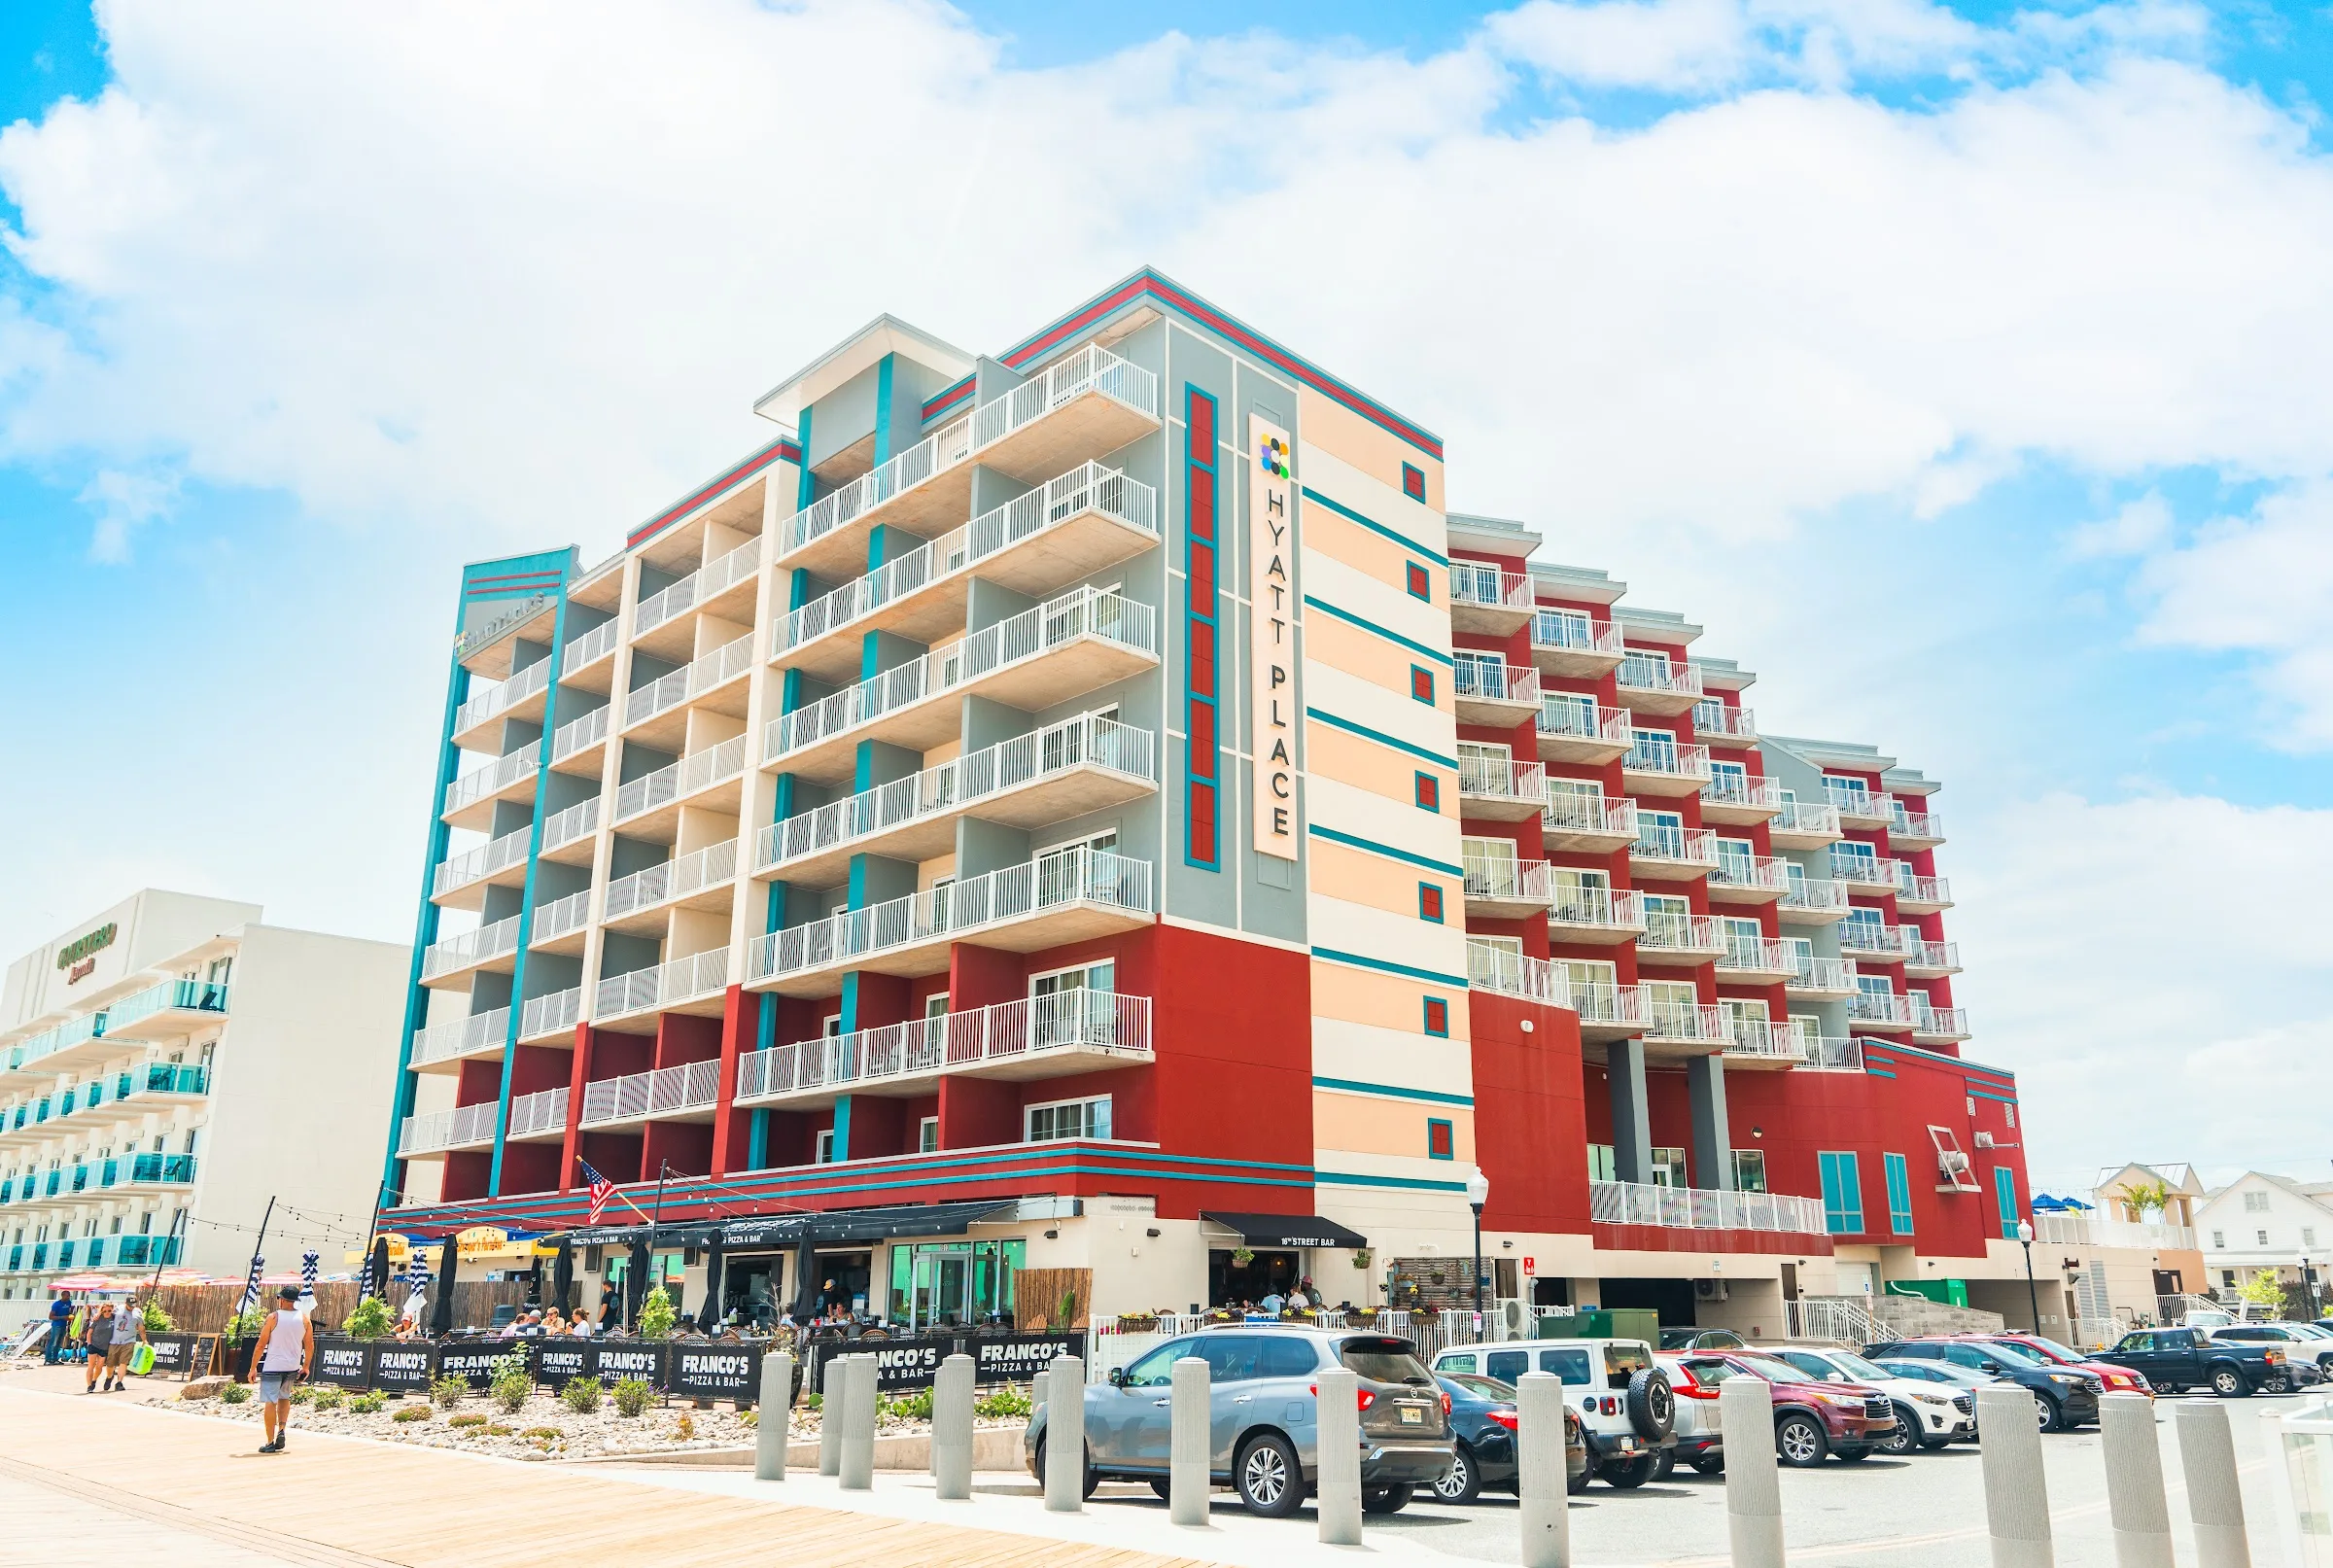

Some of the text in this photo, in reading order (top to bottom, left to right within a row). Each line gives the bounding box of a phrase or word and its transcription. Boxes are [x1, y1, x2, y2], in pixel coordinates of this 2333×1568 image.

[1268, 489, 1290, 836] HYATT PLACE
[727, 1235, 744, 1244] PIZZA
[1292, 1237, 1319, 1246] STREET
[323, 1349, 364, 1367] FRANCO'S
[980, 1342, 1068, 1362] FRANCO'S
[379, 1352, 428, 1371] FRANCO'S
[542, 1352, 583, 1367] FRANCO'S
[598, 1351, 656, 1372] FRANCO'S
[681, 1355, 749, 1376] FRANCO'S
[345, 1367, 357, 1376] BAR
[991, 1361, 1051, 1373] PIZZA & BA
[384, 1370, 401, 1379] PIZZA
[408, 1372, 420, 1380] BAR
[604, 1371, 624, 1381] PIZZA
[634, 1372, 648, 1382] BAR
[888, 1369, 896, 1379] &
[901, 1368, 924, 1378] BAR
[688, 1376, 741, 1387] PIZZA & BAR
